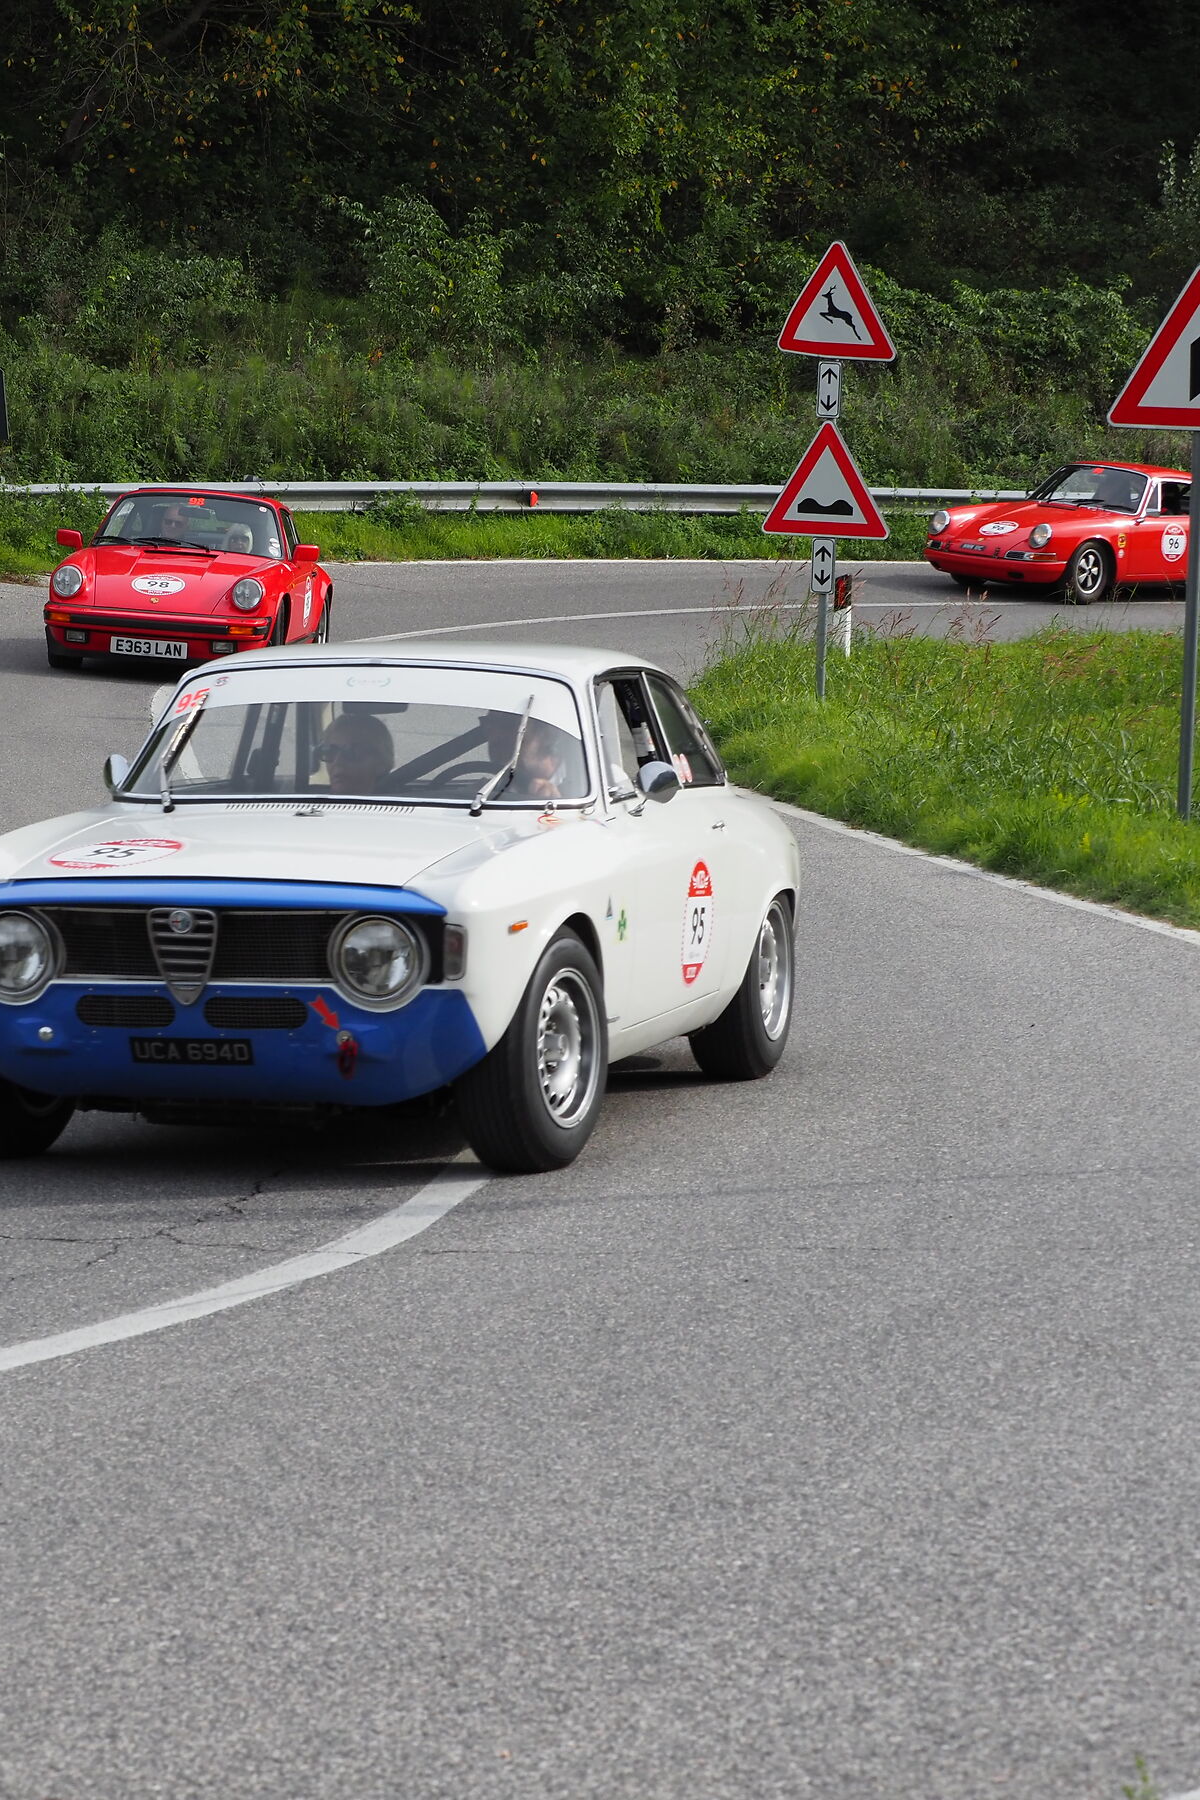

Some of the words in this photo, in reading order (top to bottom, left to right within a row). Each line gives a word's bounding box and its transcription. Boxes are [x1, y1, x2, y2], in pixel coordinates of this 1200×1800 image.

[187, 497, 206, 506] 98
[1168, 537, 1180, 549] 96
[147, 580, 170, 589] 98
[115, 639, 151, 655] E363
[155, 642, 182, 658] LAN
[85, 847, 146, 859] 95
[691, 906, 706, 945] 95
[133, 1041, 180, 1060] UCA
[186, 1043, 250, 1062] 694D
